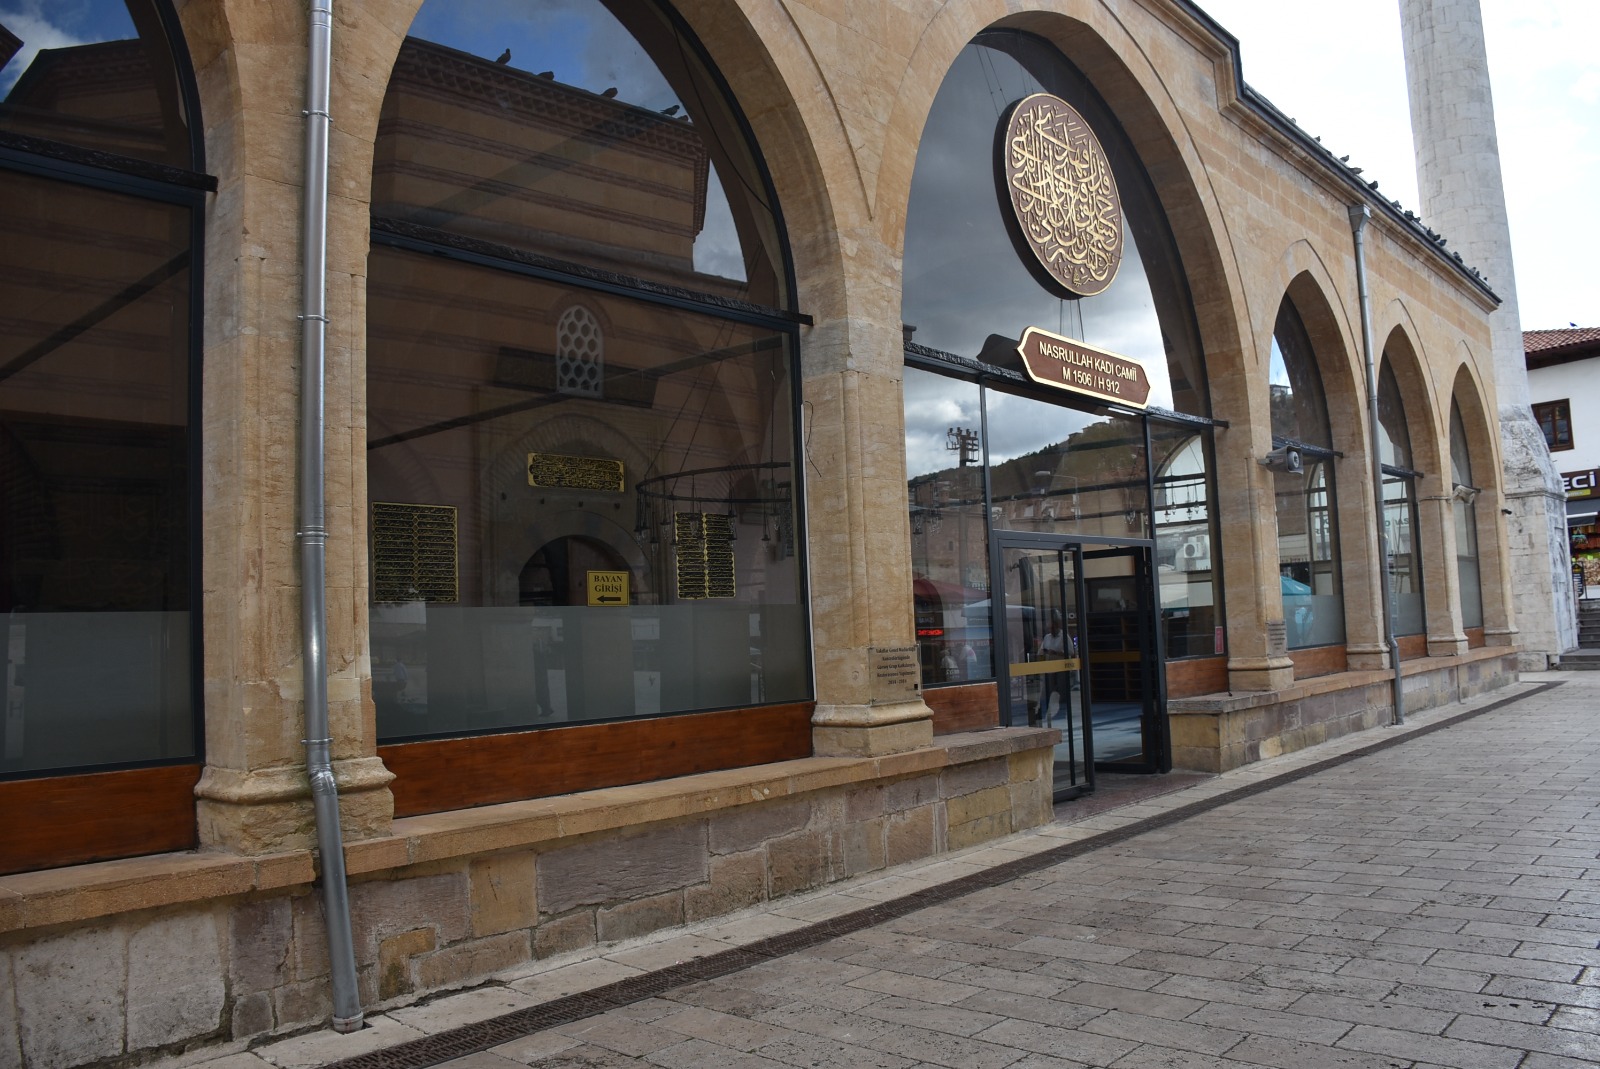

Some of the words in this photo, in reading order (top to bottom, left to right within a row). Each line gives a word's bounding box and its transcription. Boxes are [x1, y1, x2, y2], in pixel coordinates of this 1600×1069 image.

[1039, 340, 1093, 369] NASRULLAH
[1094, 358, 1114, 376] KADI
[1062, 366, 1071, 382] M
[1073, 370, 1092, 387] 1506
[1098, 377, 1105, 390] H
[1106, 378, 1120, 394] 912
[594, 575, 623, 583] BAYAN
[594, 583, 622, 594] GİRİŞİ
